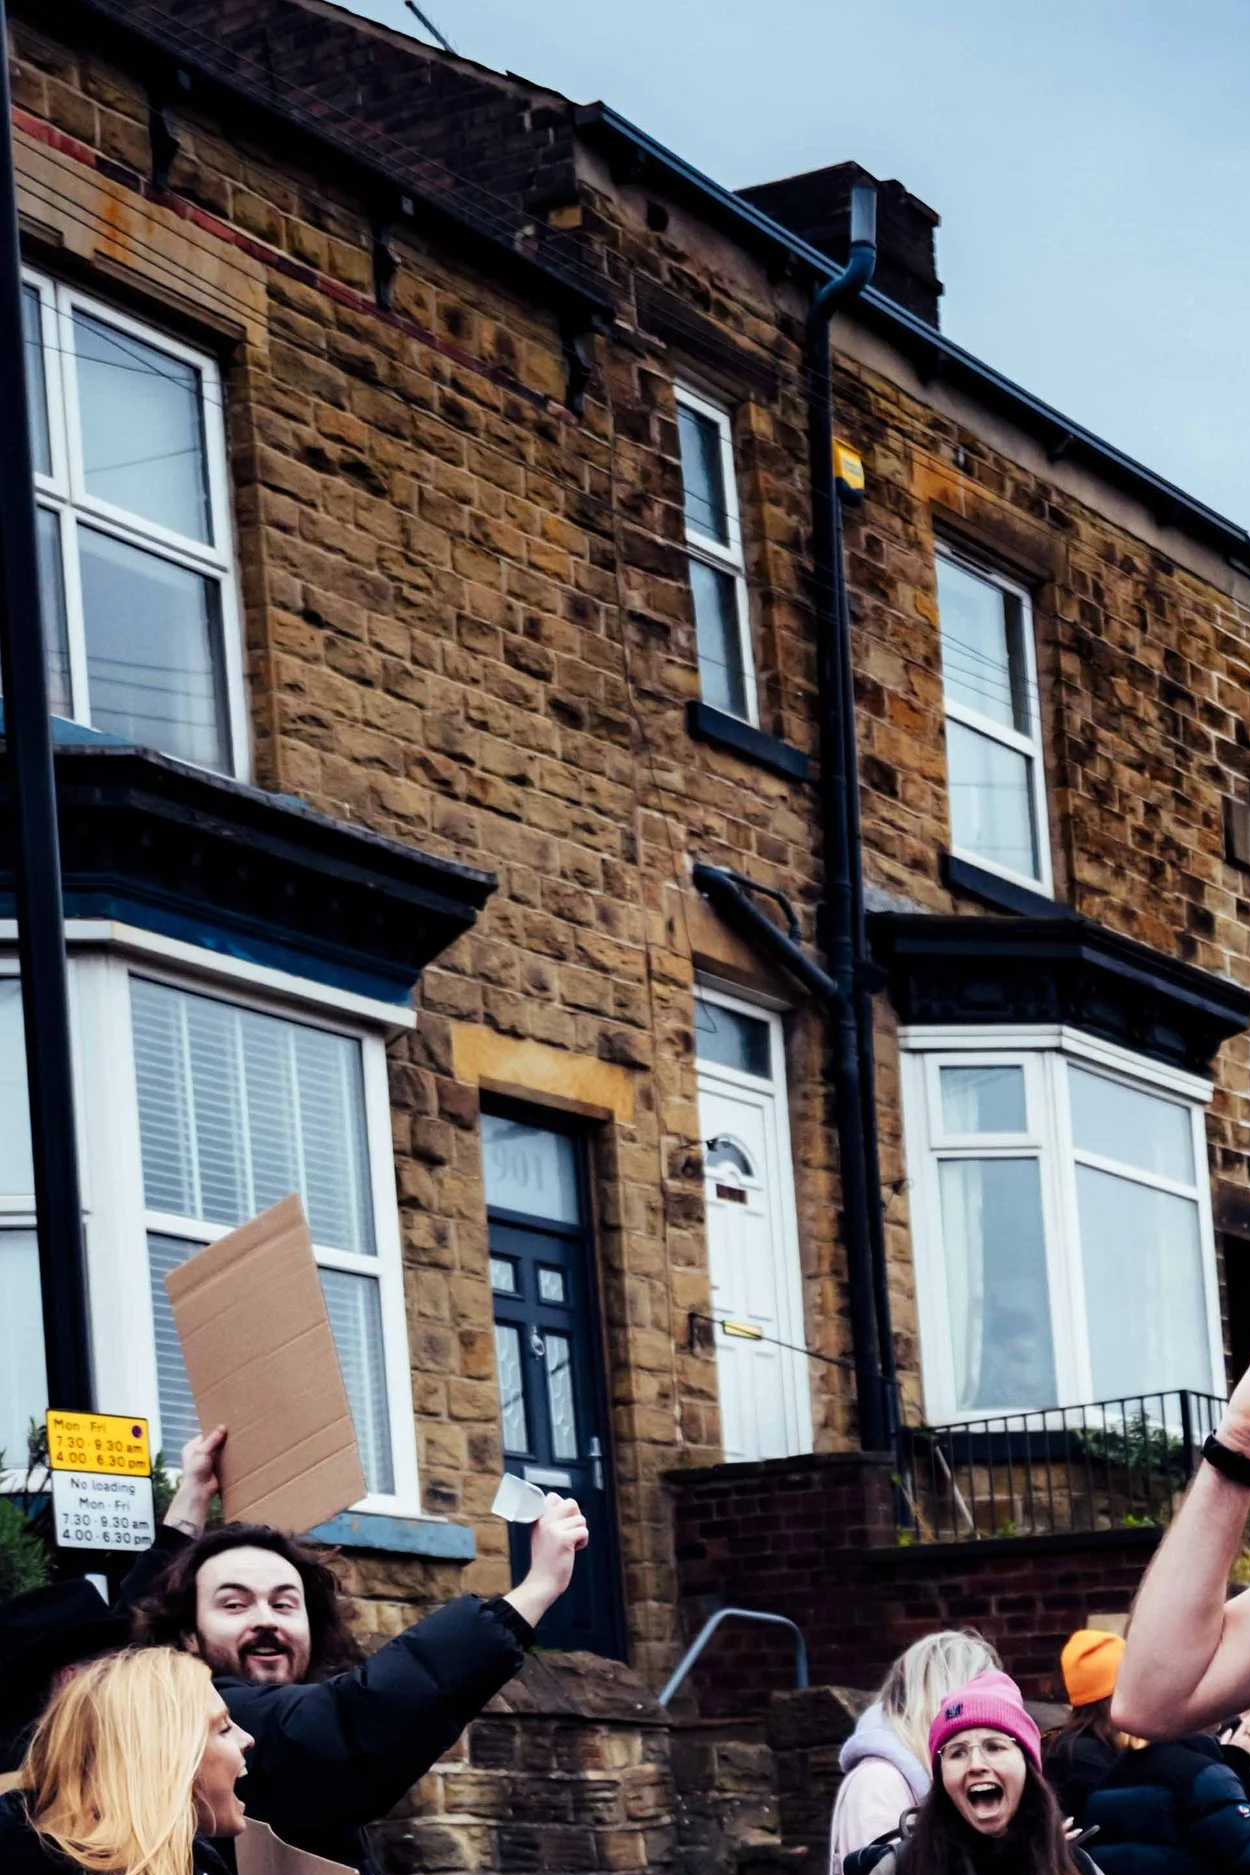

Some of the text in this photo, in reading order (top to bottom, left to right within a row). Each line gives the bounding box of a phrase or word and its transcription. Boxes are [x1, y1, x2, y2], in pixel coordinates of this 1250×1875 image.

[54, 1418, 80, 1432] Mon
[90, 1421, 107, 1434] Fri
[56, 1435, 85, 1448] 7.30
[94, 1439, 123, 1452] 9.30
[126, 1443, 144, 1454] am
[56, 1451, 87, 1464] 4.00
[97, 1454, 126, 1467] 6.30
[128, 1458, 146, 1470] pm
[70, 1477, 136, 1496] No loading
[79, 1497, 105, 1511] Mon
[115, 1500, 131, 1511] Fri
[62, 1513, 91, 1526] 7.30
[100, 1516, 130, 1529] 9.30
[132, 1520, 149, 1530] am
[62, 1529, 93, 1542] 4.00
[102, 1532, 132, 1545] 6.30
[134, 1535, 152, 1545] pm
